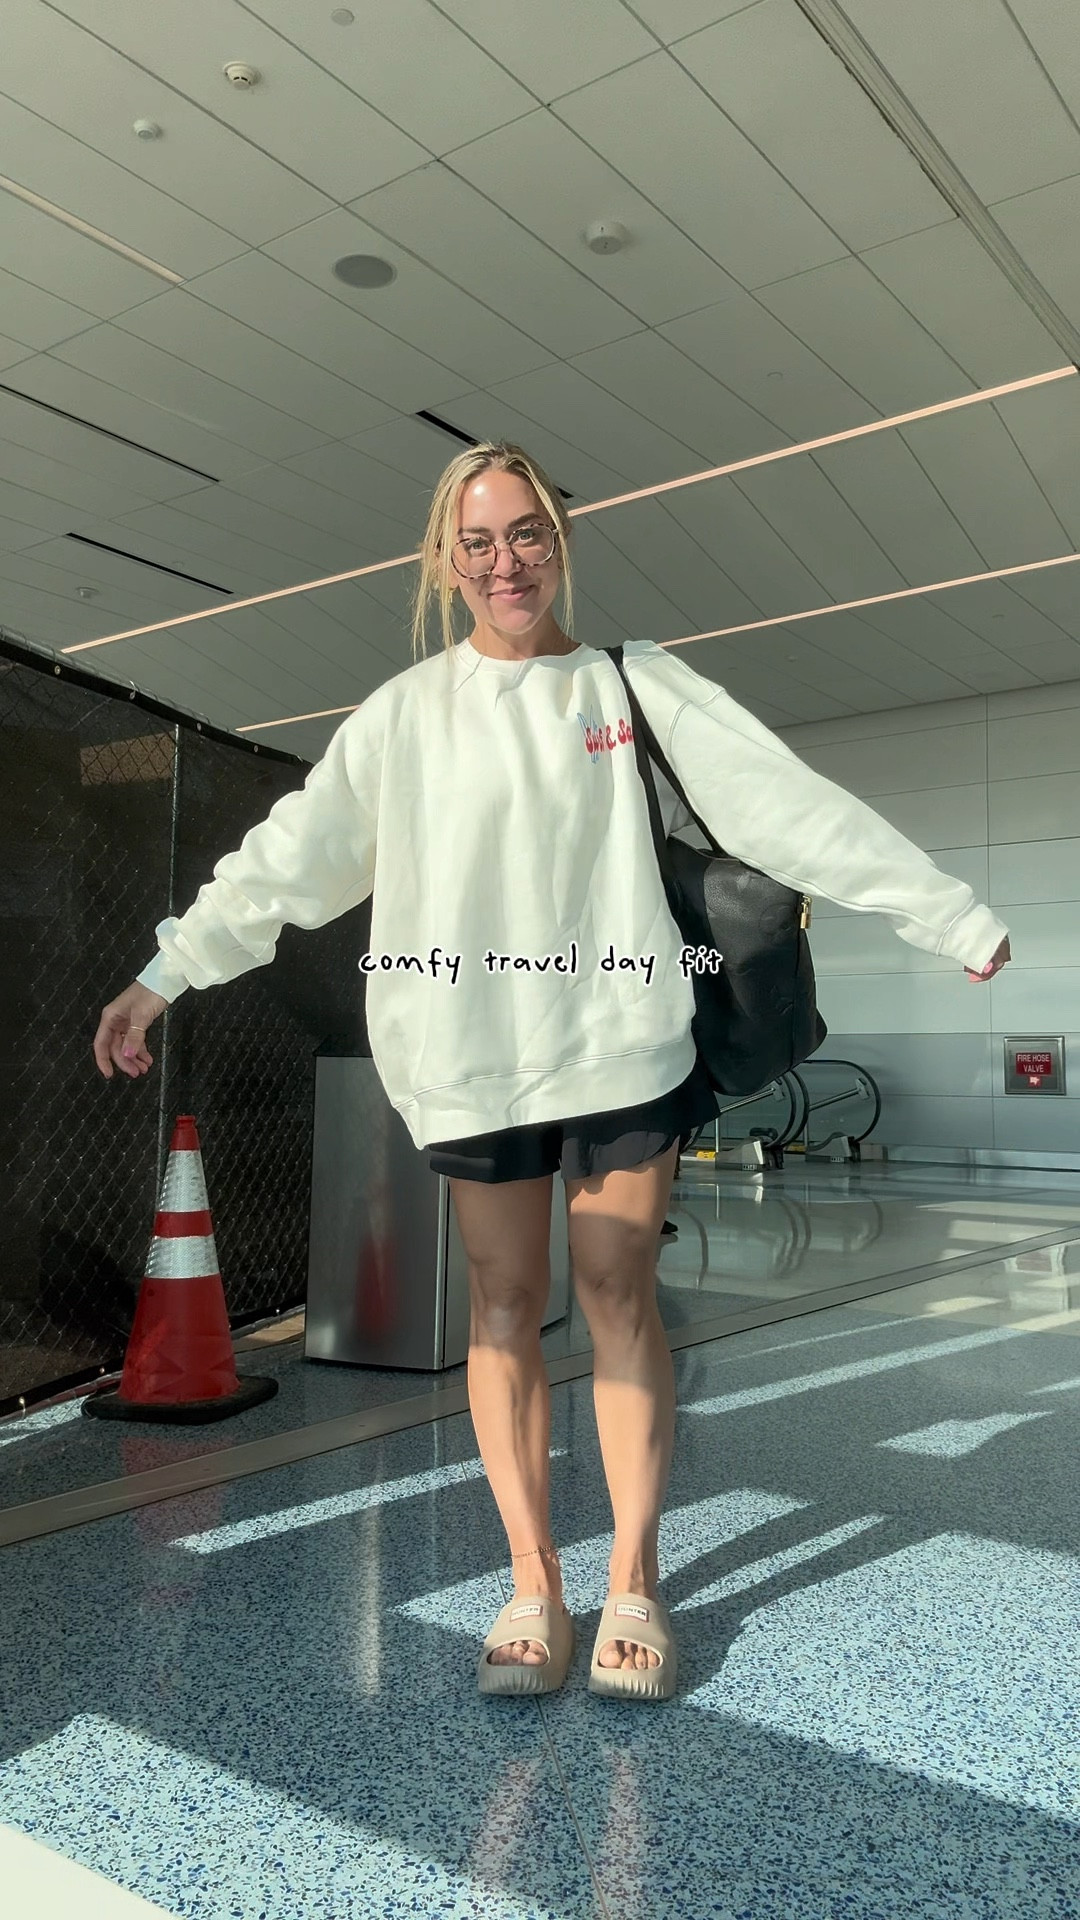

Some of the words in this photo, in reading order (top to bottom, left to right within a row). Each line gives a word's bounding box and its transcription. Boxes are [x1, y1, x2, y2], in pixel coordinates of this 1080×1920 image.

[606, 724, 616, 750] &
[618, 718, 634, 744] Sa
[1017, 1054, 1032, 1062] FIRE
[1032, 1054, 1050, 1062] HOSE
[1023, 1064, 1044, 1073] VALVE
